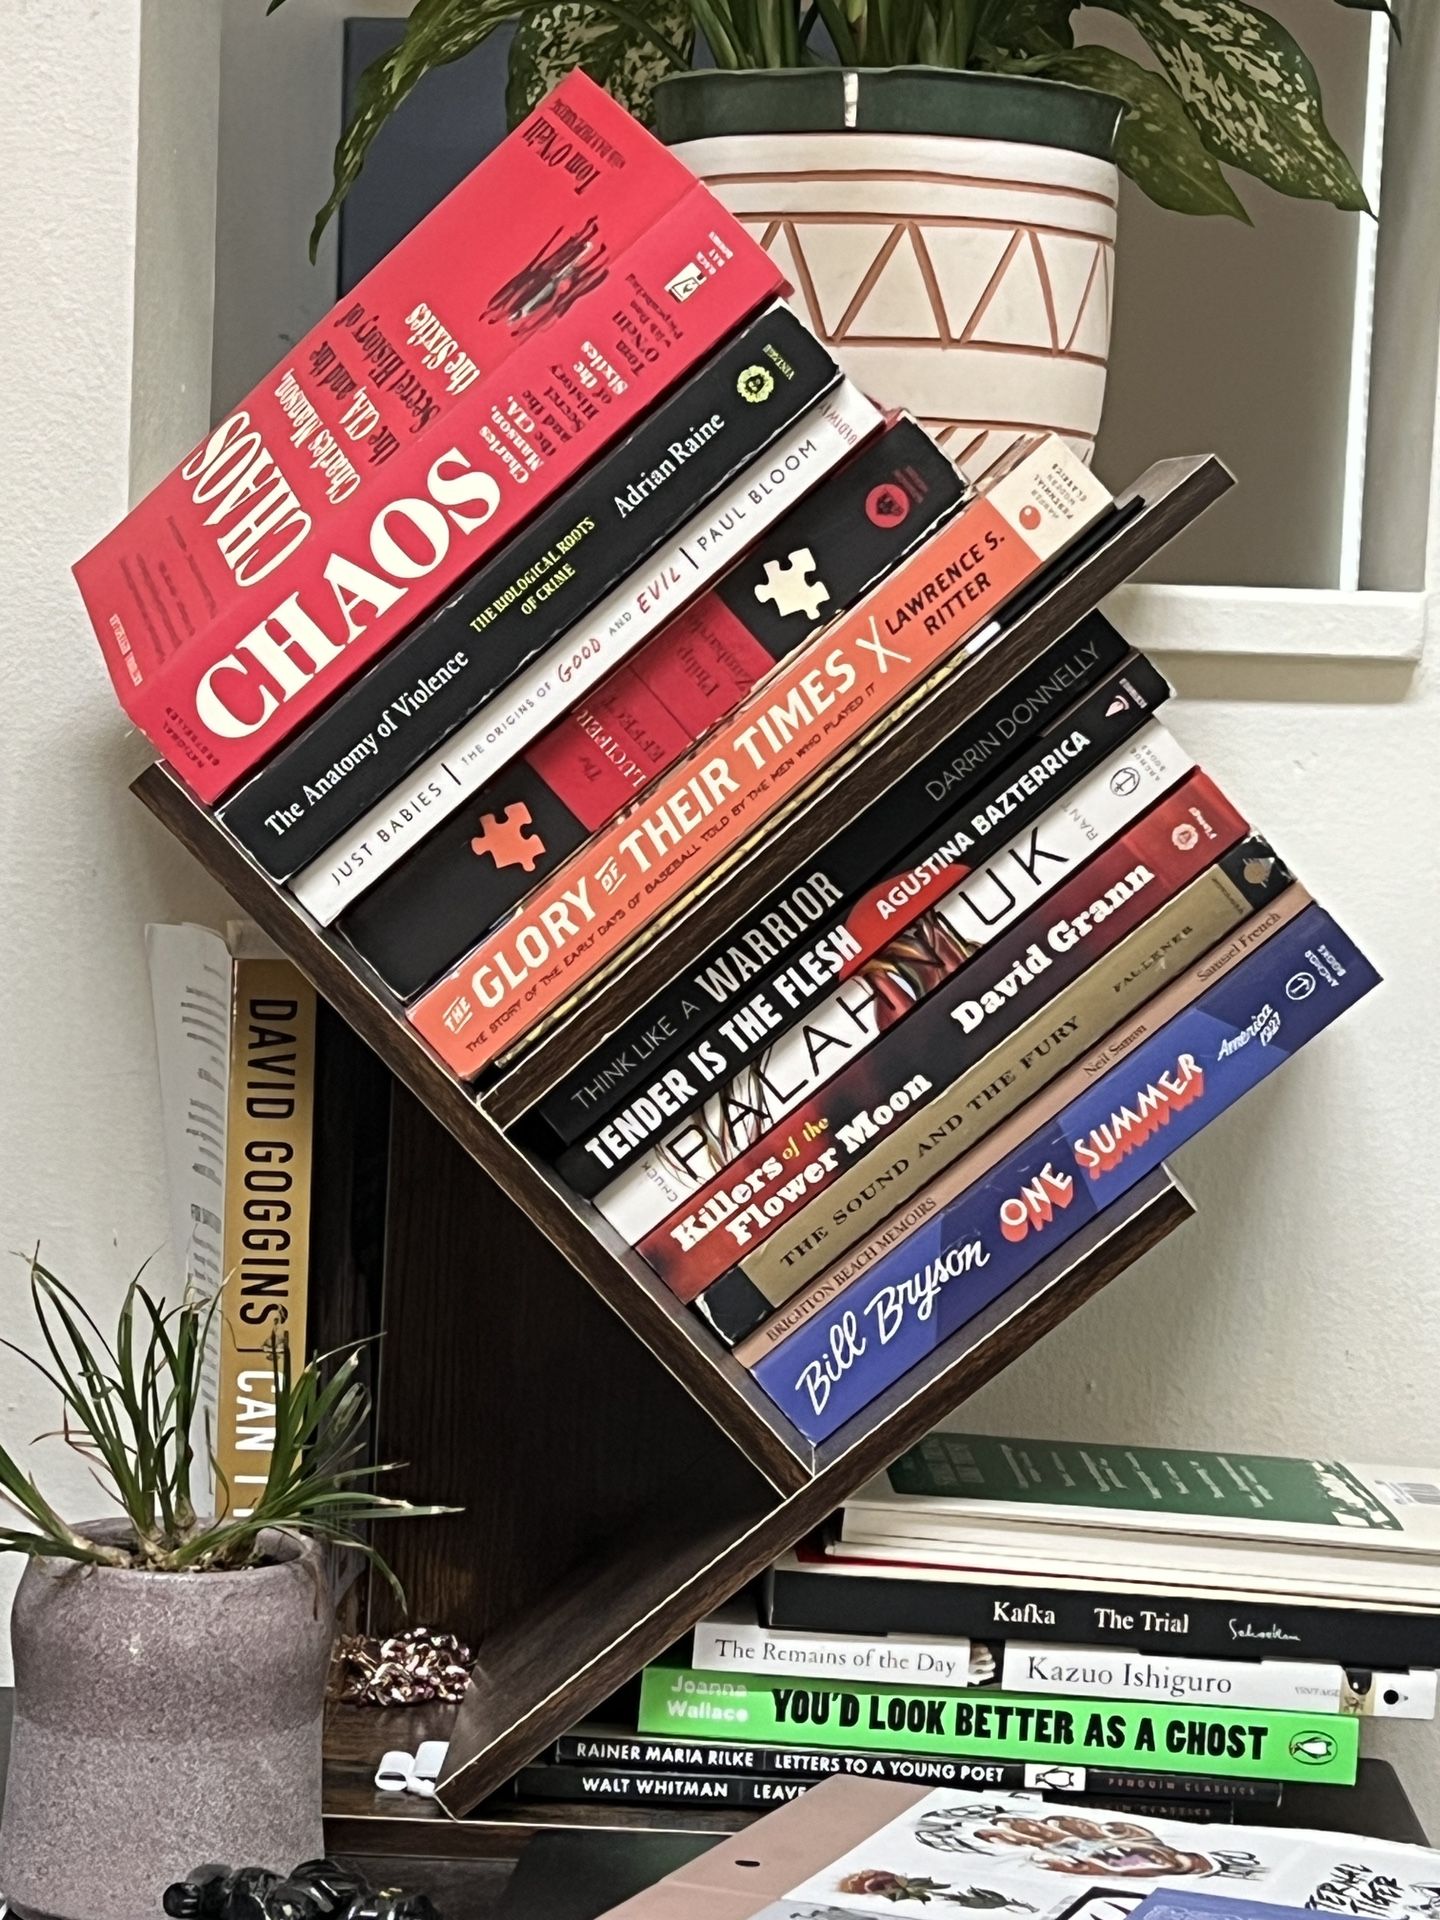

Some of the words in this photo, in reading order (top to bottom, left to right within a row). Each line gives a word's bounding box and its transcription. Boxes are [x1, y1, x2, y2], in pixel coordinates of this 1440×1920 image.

[522, 116, 570, 167] O'Neill
[565, 158, 601, 195] Tom
[334, 302, 364, 328] of
[404, 303, 458, 370] Sixties
[612, 310, 659, 363] O'Neill
[309, 340, 337, 377] the
[317, 362, 357, 400] and
[351, 315, 404, 388] History
[444, 352, 480, 395] the
[573, 361, 598, 389] the
[580, 341, 628, 395] Sixties
[615, 340, 646, 376] Tom
[274, 368, 323, 448] Manson,
[339, 386, 380, 441] CIA,
[386, 369, 440, 434] Secret
[522, 390, 544, 415] the
[543, 386, 585, 433] Secret
[551, 364, 600, 421] History
[592, 387, 612, 404] of
[368, 425, 400, 466] the
[479, 426, 529, 484] Charles
[491, 406, 544, 471] Manson,
[534, 430, 557, 456] the
[542, 415, 573, 443] and
[308, 429, 360, 504] Charles
[613, 456, 676, 519] Adrian
[667, 413, 726, 465] Raine
[696, 507, 746, 551] PAUL
[748, 439, 817, 505] BLOOM
[182, 411, 311, 587] CHAOS
[195, 447, 501, 739] CHAOS
[469, 607, 498, 632] THE
[492, 551, 561, 613] BIOLOGICAL
[556, 516, 596, 554] ROOTS
[521, 596, 538, 616] OF
[535, 563, 576, 602] CRIME
[885, 543, 985, 635] LAWRENCE
[984, 530, 1005, 551] S.
[923, 571, 992, 636] RITTER
[461, 744, 485, 766] THE
[485, 698, 535, 744] ORIGINS
[536, 680, 552, 699] OF
[558, 638, 602, 683] GOOD
[608, 612, 632, 636] AND
[637, 567, 681, 614] EVIL
[677, 647, 720, 697] Philip
[264, 801, 305, 836] The
[301, 733, 379, 806] Anatomy
[377, 711, 398, 738] of
[391, 651, 469, 719] Violence
[576, 710, 647, 788] LUCIFER
[601, 696, 666, 763] EFFECT
[925, 731, 1001, 802] DARRIN
[996, 641, 1100, 739] DONNELLY
[578, 756, 602, 782] The
[332, 843, 372, 886] JUST
[377, 782, 442, 842] BABIES
[443, 999, 472, 1033] THE
[471, 876, 596, 1008] GLORY
[598, 860, 625, 893] OF
[618, 758, 740, 873] THEIR
[733, 648, 855, 770] TIMES
[875, 831, 975, 920] AGUSTINA
[970, 730, 1091, 836] BAZTERRICA
[1060, 802, 1099, 841] RANT
[465, 1033, 488, 1053] THE
[489, 999, 521, 1034] STORY
[525, 985, 539, 1001] OF
[539, 966, 562, 986] THE
[563, 934, 595, 966] EARLY
[597, 910, 626, 936] DAYS
[628, 892, 641, 909] OF
[644, 844, 701, 893] BASEBALL
[701, 816, 730, 842] TOLD
[732, 802, 747, 817] BY
[750, 781, 770, 801] THE
[771, 758, 794, 781] MEN
[796, 733, 821, 758] WHO
[823, 695, 863, 734] PLAYED
[865, 682, 876, 698] IT
[950, 944, 1053, 1034] David
[1047, 864, 1155, 953] Grann
[1112, 925, 1193, 993] FAULKNER
[1197, 941, 1241, 984] Samuel
[1238, 912, 1281, 952] French
[570, 1052, 637, 1110] THINK
[631, 1015, 677, 1060] LIKE
[681, 1000, 700, 1019] A
[694, 871, 844, 1003] WARRIOR
[666, 827, 1069, 1184] PALAHNIUK
[246, 999, 298, 1119] DAVID
[584, 1068, 698, 1169] TENDER
[687, 1040, 727, 1082] IS
[718, 993, 783, 1053] THE
[772, 924, 862, 1009] FLESH
[1217, 1003, 1273, 1062] America
[1259, 1011, 1282, 1047] 1927
[1083, 1053, 1111, 1077] Neil
[724, 1147, 839, 1247] Flower
[835, 1074, 933, 1155] Moon
[780, 1226, 829, 1268] THE
[832, 1158, 910, 1225] SOUND
[917, 1114, 963, 1158] AND
[966, 1070, 1016, 1111] THE
[1019, 1015, 1080, 1069] FURY
[1000, 1162, 1073, 1232] ONE
[1073, 1053, 1203, 1174] SUMMER
[642, 1160, 678, 1203] CHUCK
[669, 1156, 783, 1252] Killers
[782, 1136, 801, 1161] of
[802, 1117, 829, 1143] the
[239, 1140, 294, 1325] GOGGINS
[765, 1283, 835, 1343] BRIGHTON
[833, 1247, 877, 1288] BEACH
[875, 1197, 938, 1250] MEMOIRS
[795, 1310, 866, 1416] Bill
[863, 1240, 990, 1345] Bryson
[993, 1601, 1056, 1625] Kafka
[1094, 1607, 1134, 1630] The
[1140, 1610, 1189, 1634] Trial
[671, 1675, 748, 1698] Joanna
[715, 1638, 755, 1660] The
[762, 1641, 846, 1666] Remains
[853, 1648, 875, 1668] of
[879, 1650, 909, 1670] the
[917, 1652, 956, 1678] Day
[1026, 1656, 1113, 1684] Kazuo
[1123, 1661, 1232, 1698] Ishiguro
[666, 1700, 749, 1723] Wallace
[1295, 1685, 1340, 1698] VINTAGE
[576, 1742, 640, 1760] RAINER
[645, 1746, 703, 1764] MARIA
[707, 1750, 754, 1767] RILKE
[771, 1688, 860, 1728] YOU'D
[869, 1695, 947, 1736] LOOK
[955, 1702, 1075, 1745] BETTER
[1084, 1713, 1127, 1749] AS
[1134, 1716, 1156, 1752] A
[1165, 1719, 1269, 1761] GHOST
[582, 1777, 630, 1794] WALT
[636, 1779, 728, 1797] WHITMAN
[774, 1753, 840, 1773] LETTERS
[845, 1758, 867, 1773] TO
[871, 1760, 885, 1775] A
[890, 1761, 956, 1780] YOUNG
[960, 1765, 1004, 1783] POET
